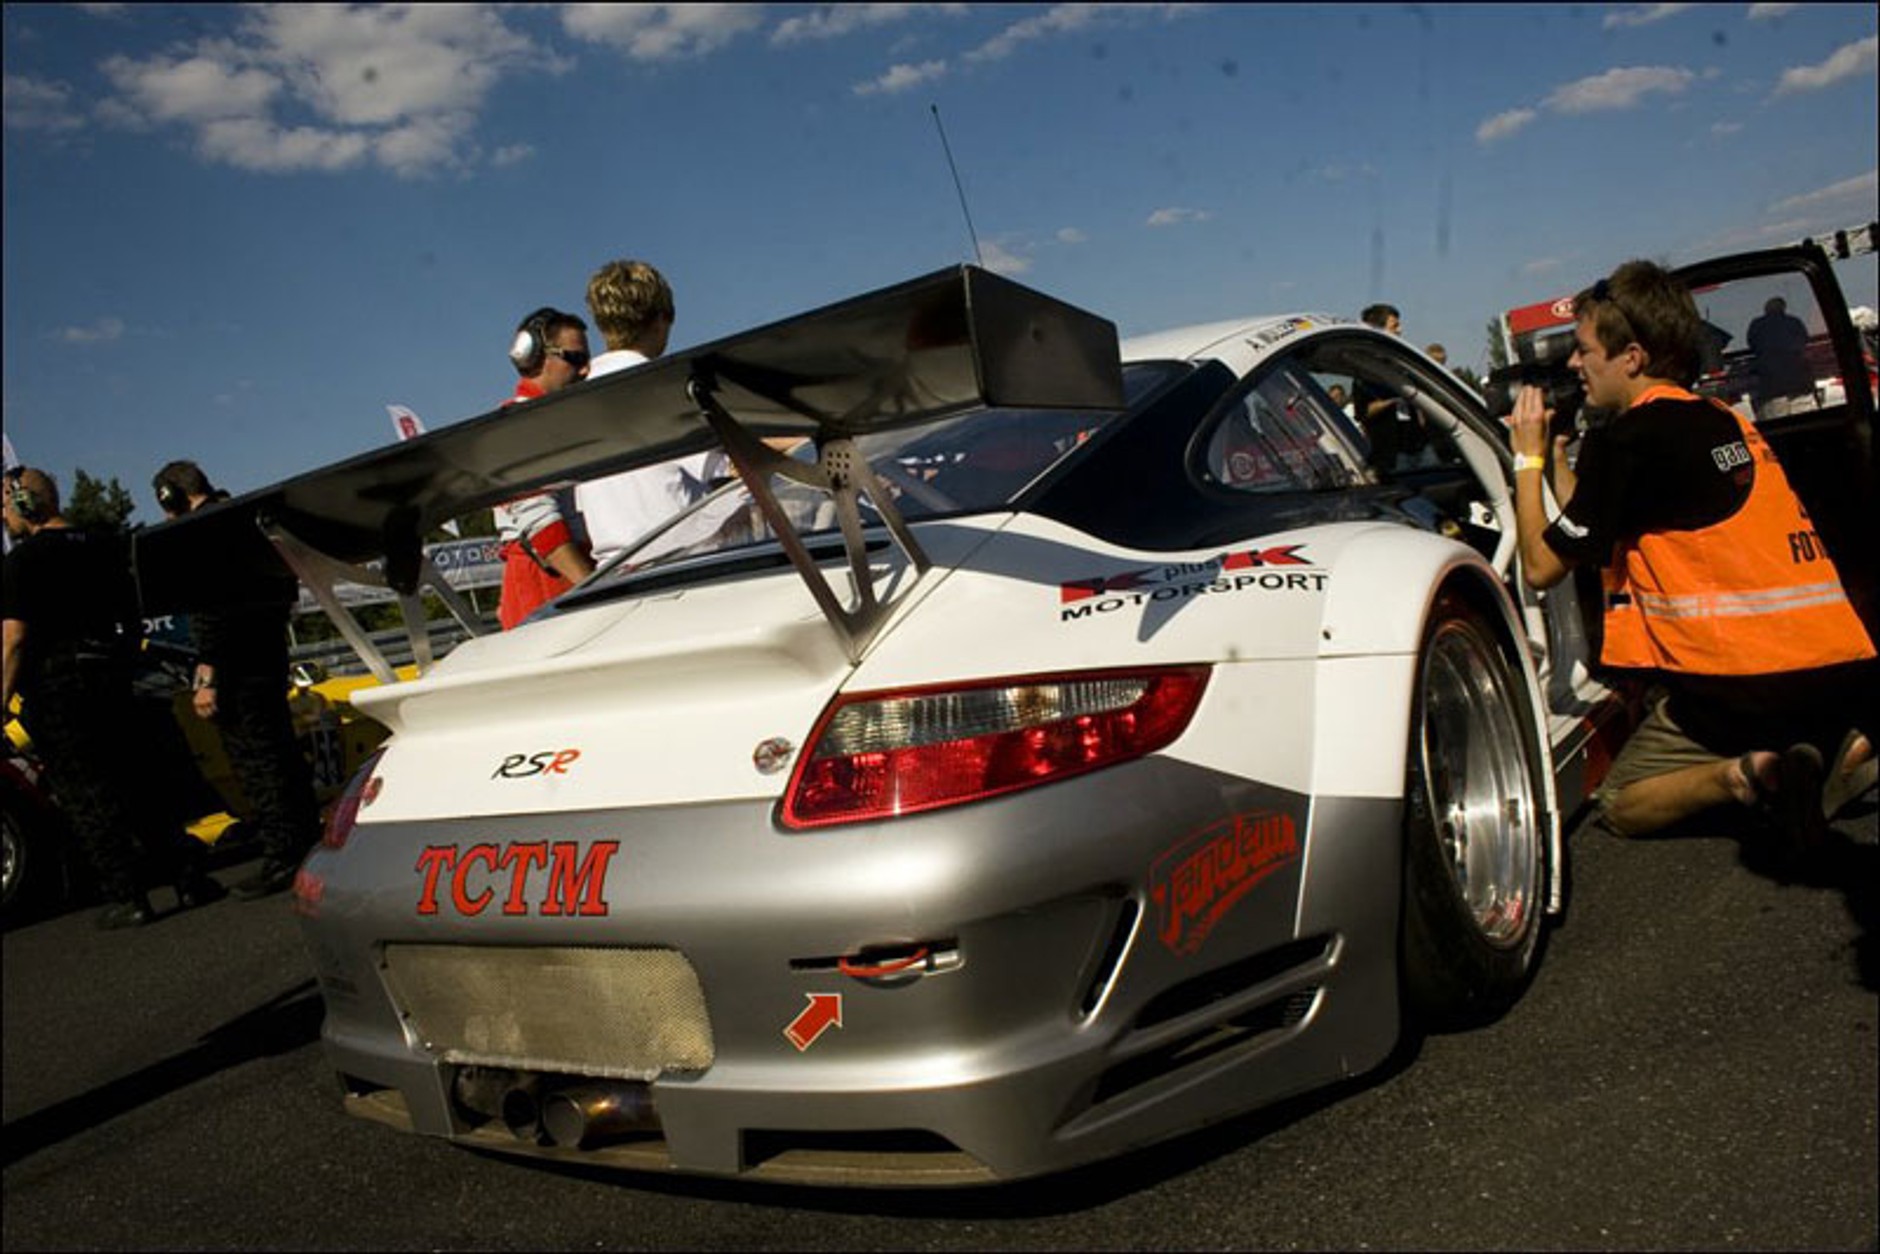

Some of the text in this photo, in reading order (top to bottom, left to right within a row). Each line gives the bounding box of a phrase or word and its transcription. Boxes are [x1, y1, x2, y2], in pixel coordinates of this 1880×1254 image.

[1163, 560, 1220, 580] plus
[1060, 572, 1329, 622] MOTORSPORT
[491, 748, 581, 780] RSR
[414, 840, 621, 917] TCTM
